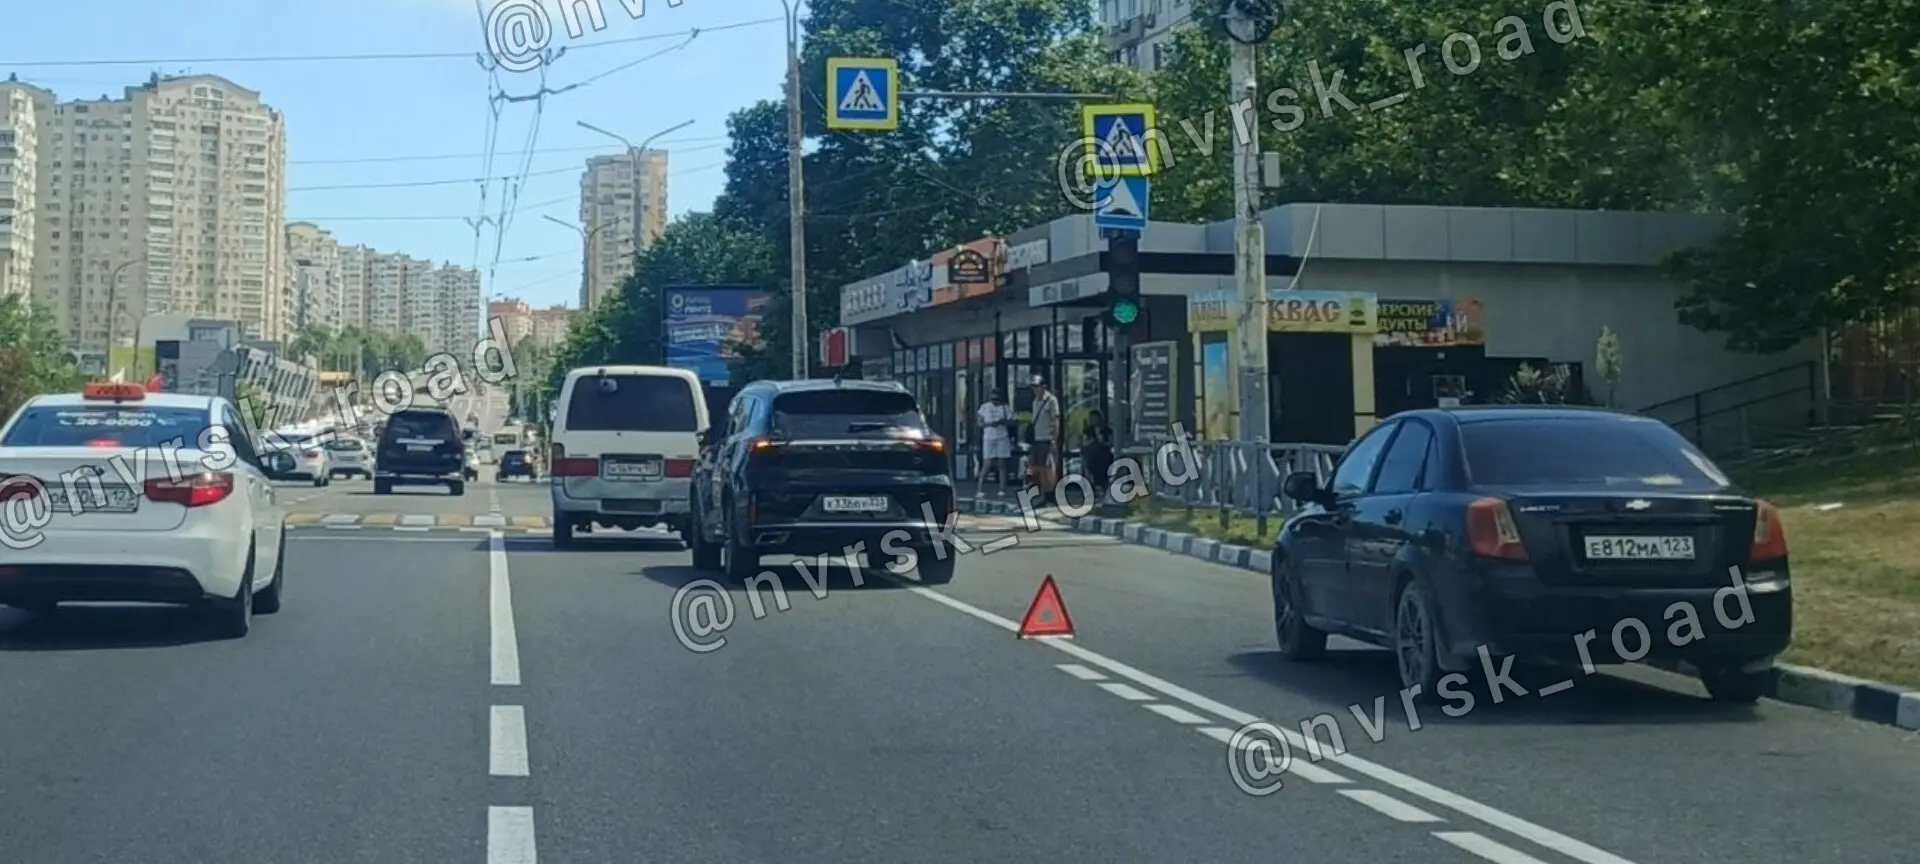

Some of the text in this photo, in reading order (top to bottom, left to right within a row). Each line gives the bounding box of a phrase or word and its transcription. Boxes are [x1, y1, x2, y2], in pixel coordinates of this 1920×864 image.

[1268, 299, 1341, 322] КВАС
[1590, 538, 1691, 557] Е812МА 123
